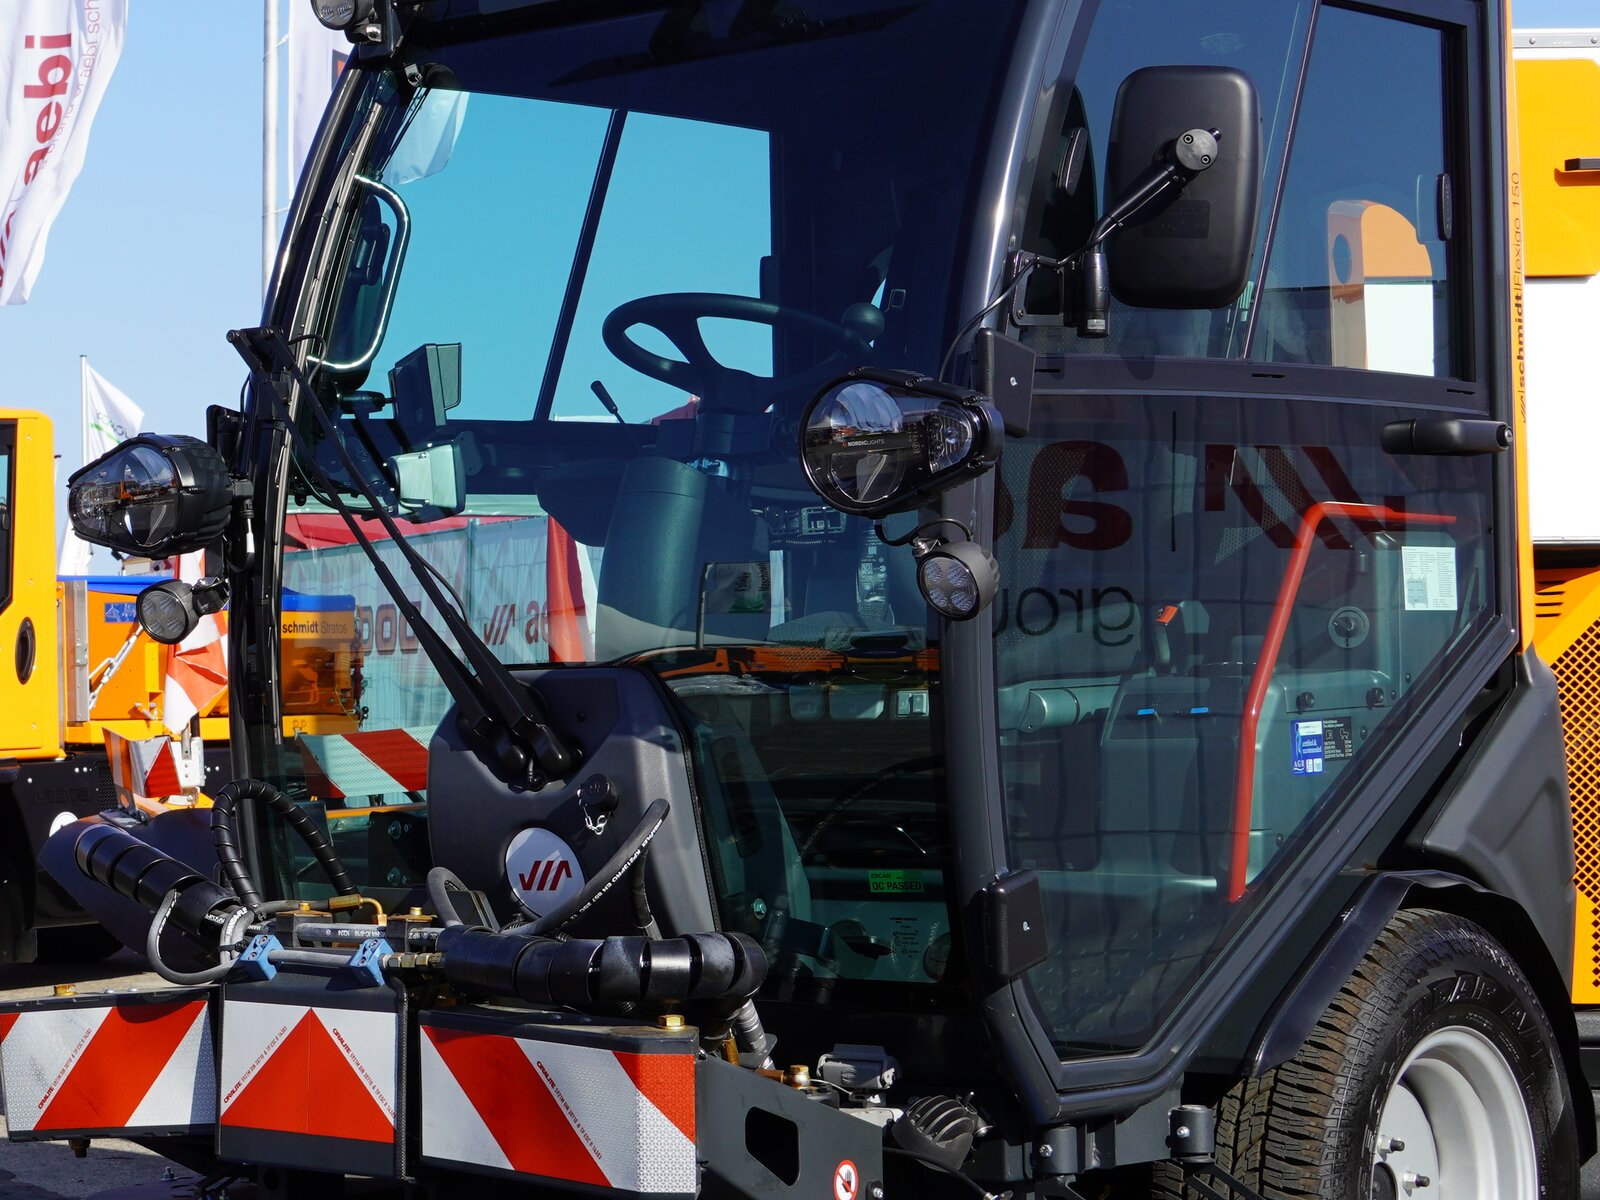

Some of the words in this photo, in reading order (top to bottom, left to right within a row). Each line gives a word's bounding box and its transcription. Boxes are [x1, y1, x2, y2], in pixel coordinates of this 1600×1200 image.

[24, 33, 72, 186] aebi
[1511, 172, 1521, 207] 150
[1514, 293, 1526, 388] schmidt
[282, 621, 319, 635] schmidt
[320, 621, 348, 634] Stratos
[872, 881, 885, 891] QC
[886, 881, 922, 891] PASSED
[331, 1027, 351, 1053] ORALITE
[535, 1060, 555, 1088] ORALITE
[37, 1086, 54, 1109] ORALITE
[222, 1080, 242, 1103] ORALITE
